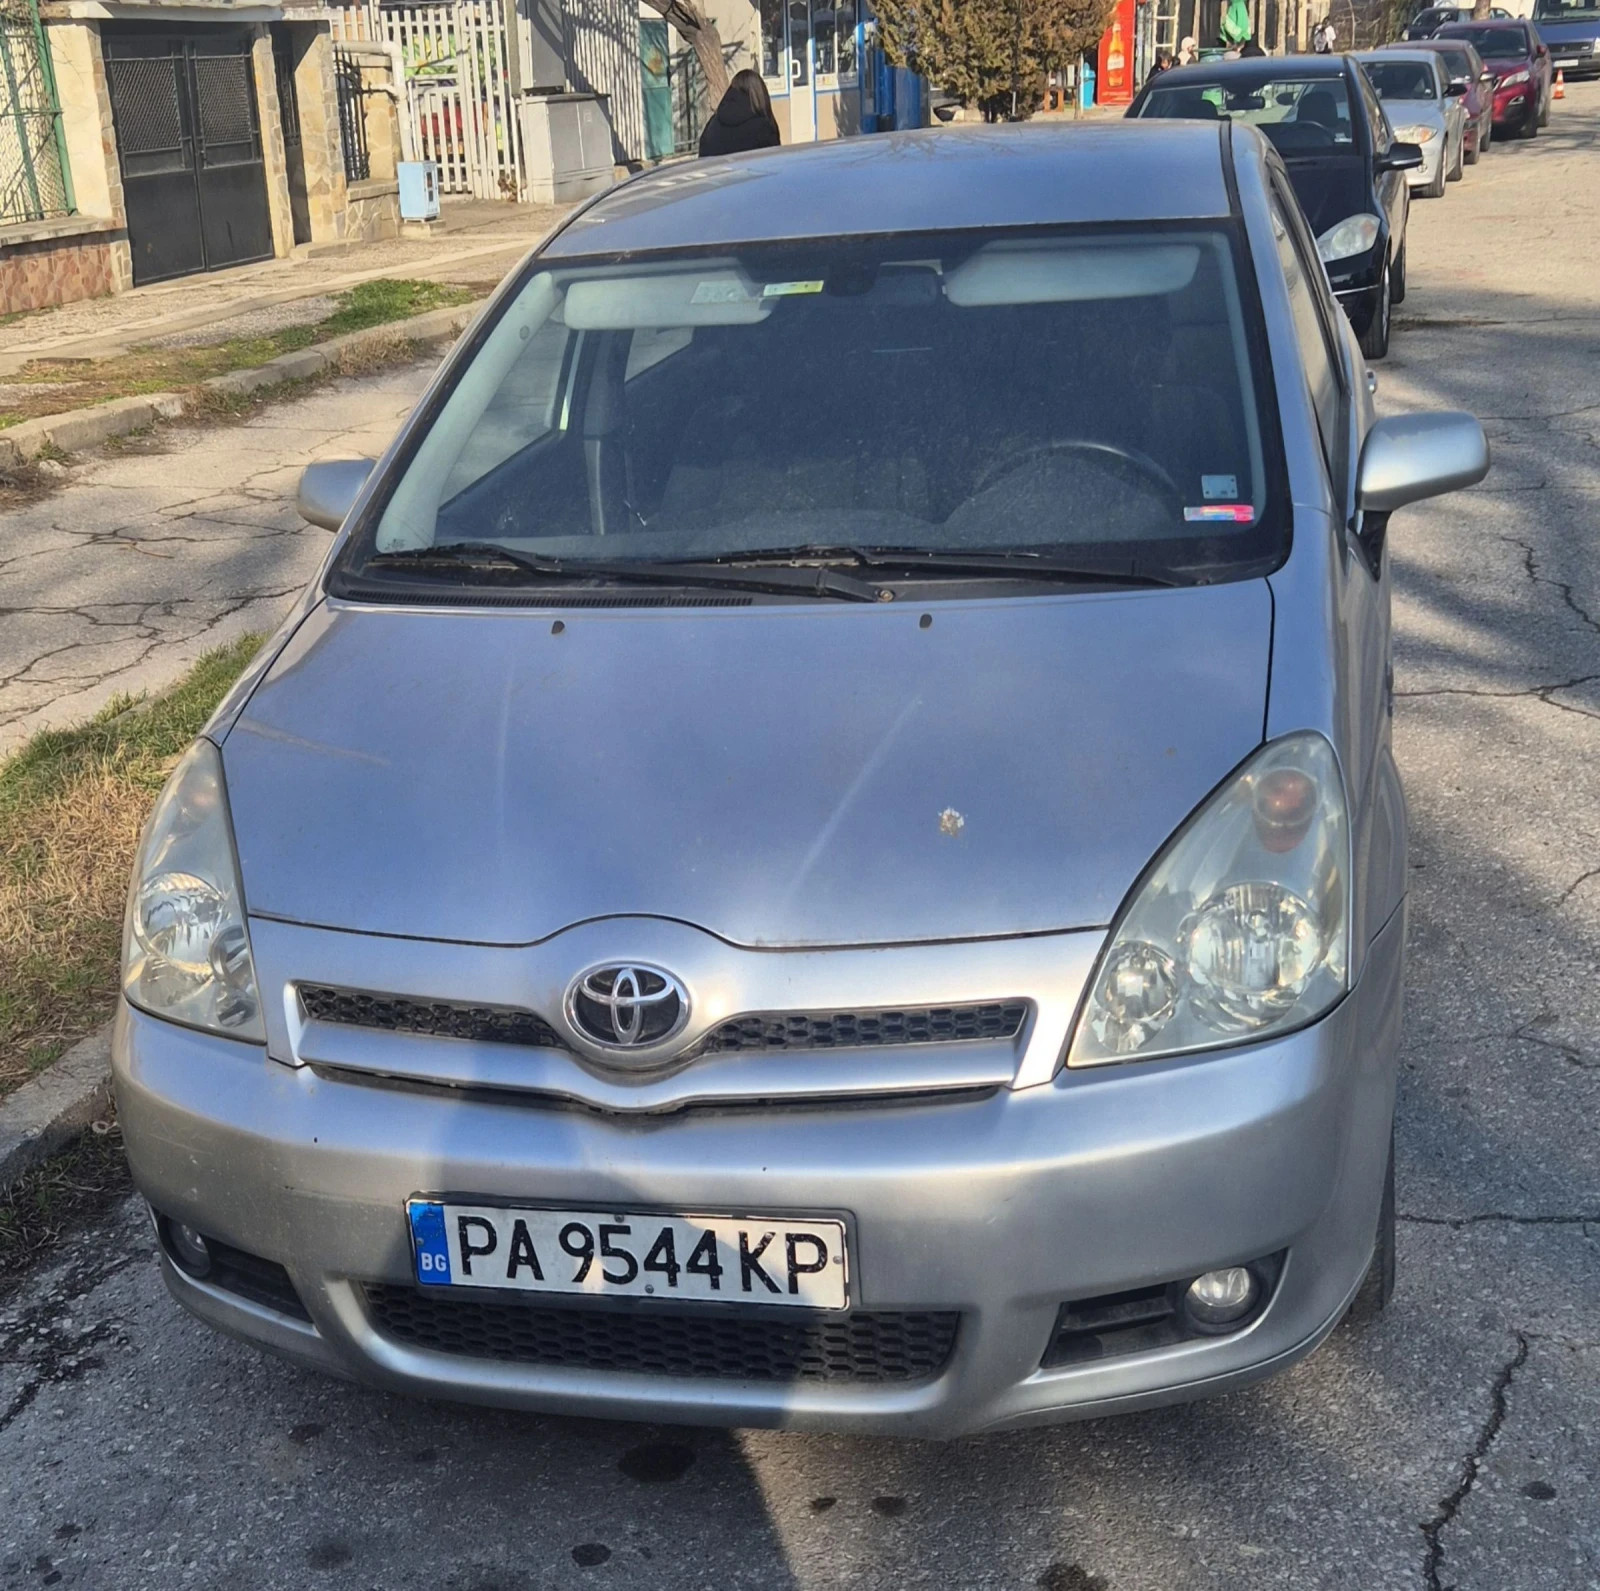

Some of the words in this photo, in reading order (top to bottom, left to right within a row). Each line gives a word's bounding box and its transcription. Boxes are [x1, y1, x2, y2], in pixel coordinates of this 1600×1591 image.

[421, 1252, 447, 1272] BG
[458, 1215, 545, 1281] PA
[558, 1222, 723, 1290] 9544
[738, 1230, 829, 1295] KP
